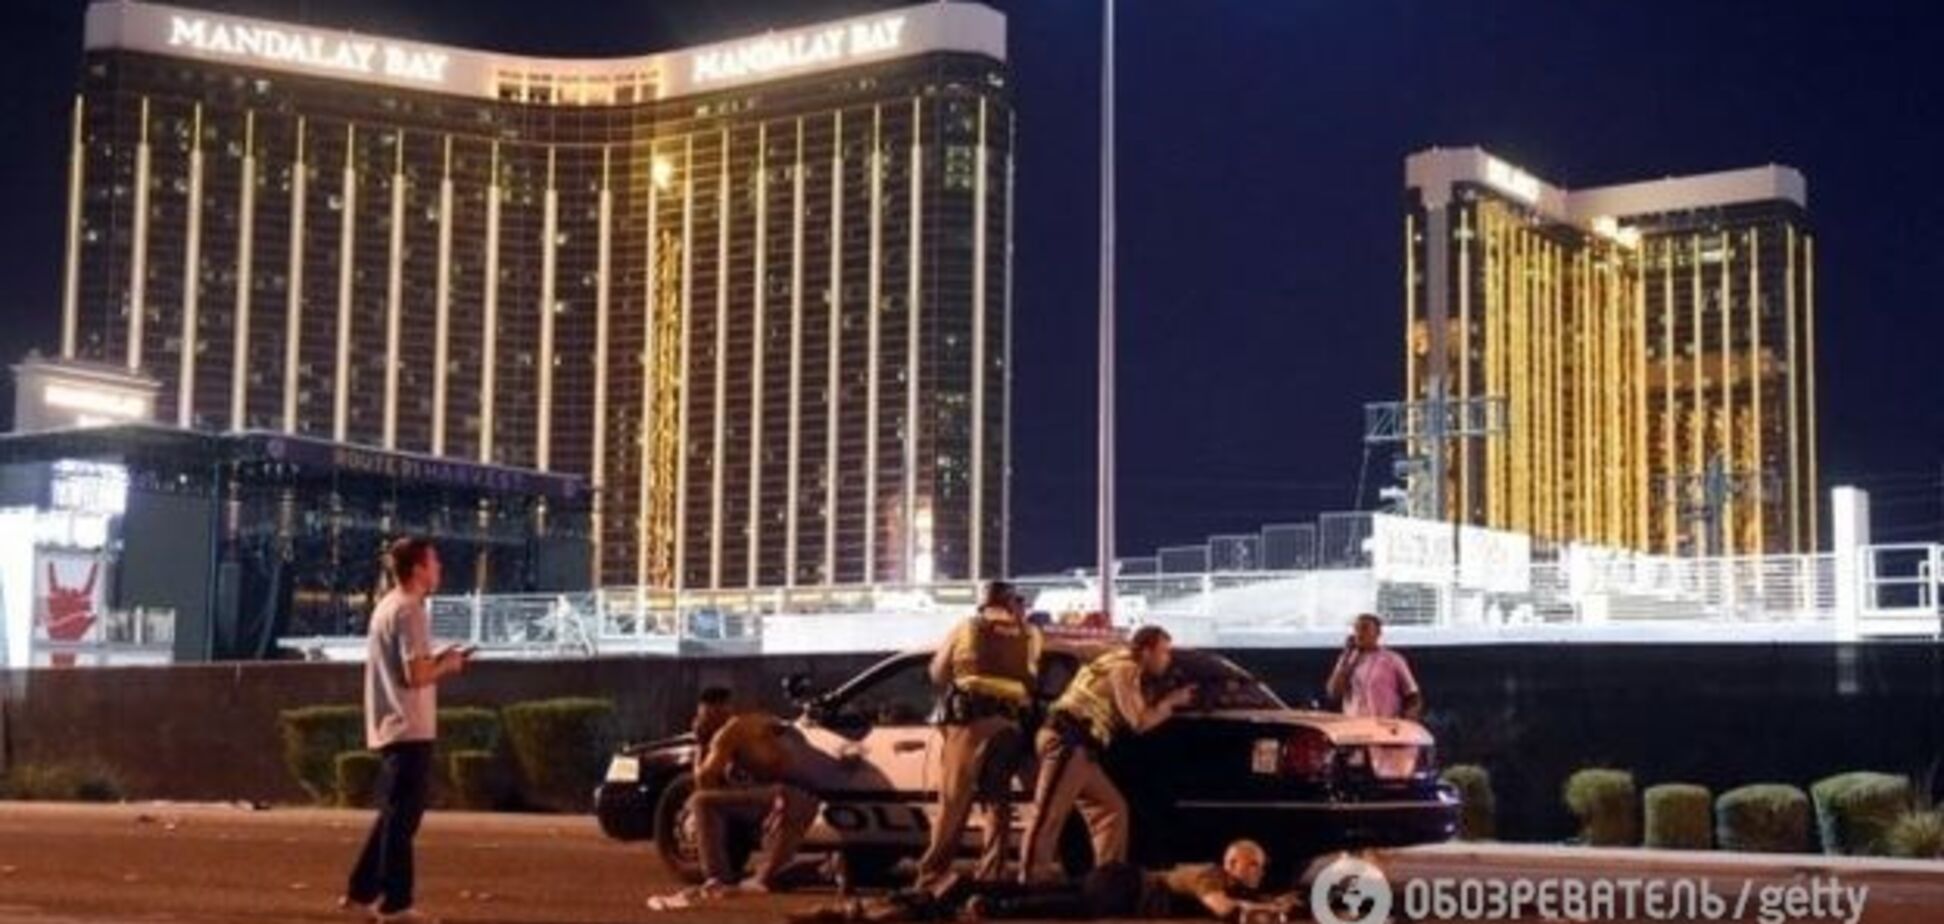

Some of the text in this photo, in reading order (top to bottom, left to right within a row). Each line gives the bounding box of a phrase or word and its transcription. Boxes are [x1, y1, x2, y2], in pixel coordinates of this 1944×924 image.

[169, 16, 449, 81] MANDALAY BAY
[693, 16, 906, 84] MANDALAY BAY
